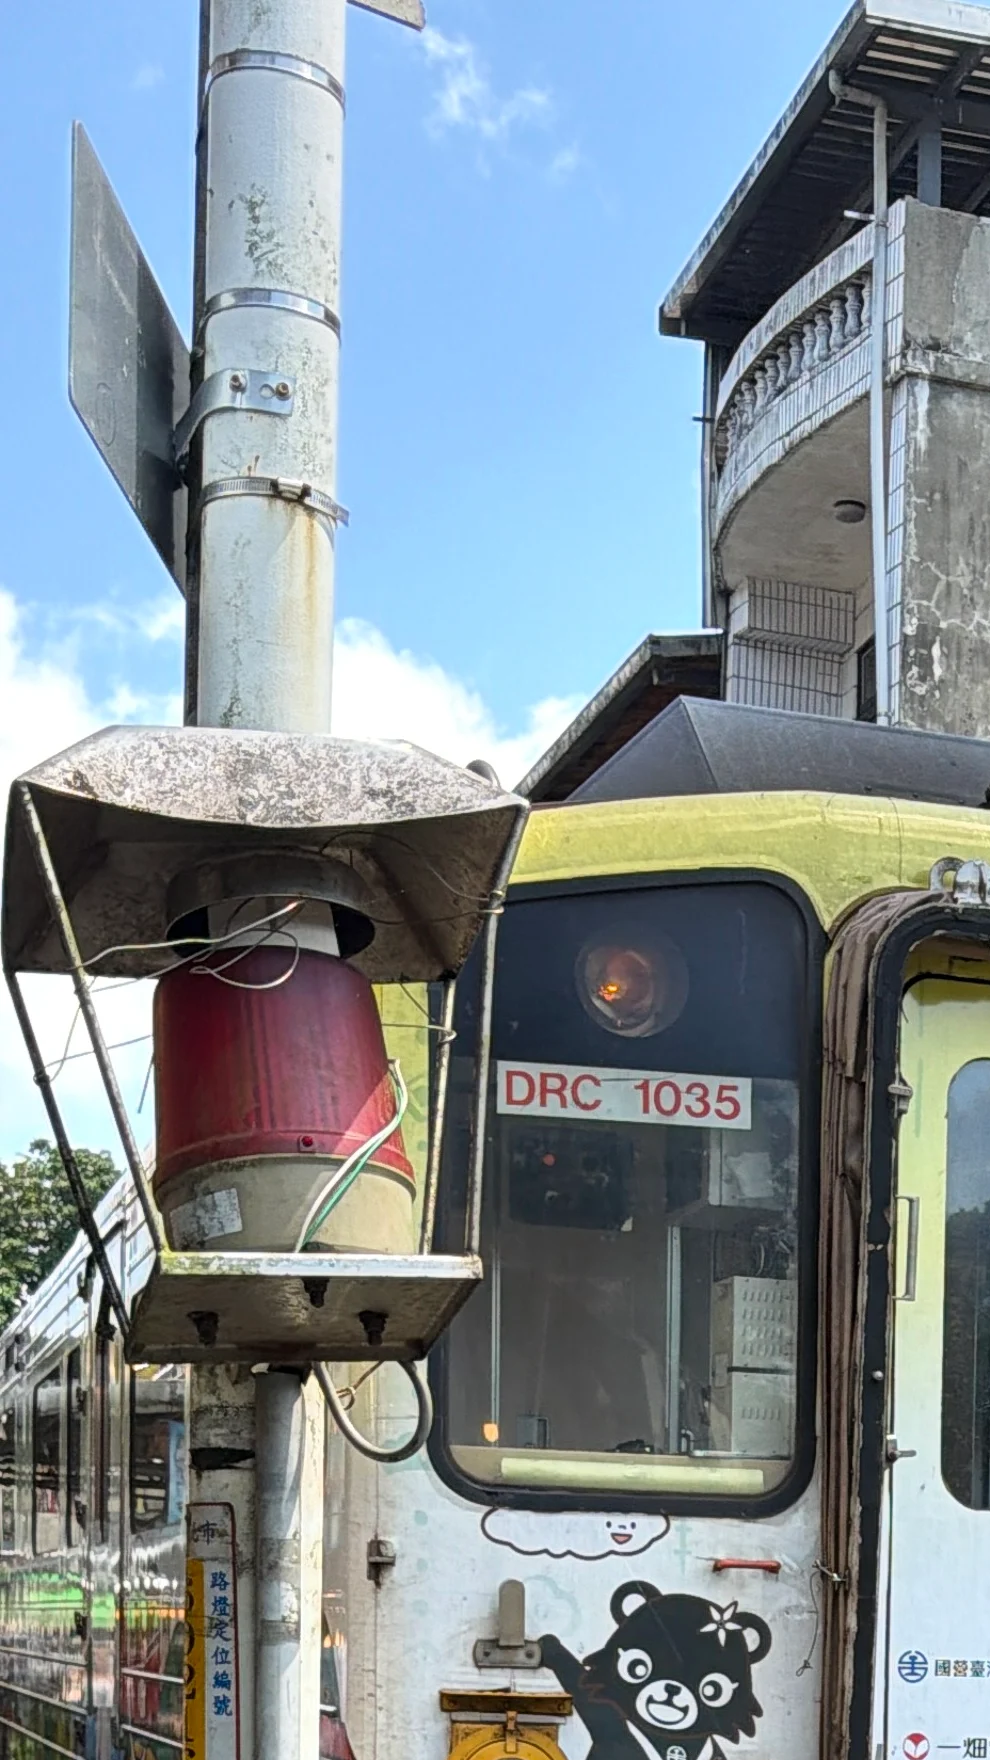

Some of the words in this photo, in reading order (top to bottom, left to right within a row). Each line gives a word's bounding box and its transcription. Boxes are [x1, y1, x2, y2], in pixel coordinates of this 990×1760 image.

[505, 1070, 602, 1111] DRC
[634, 1079, 741, 1121] 1035
[210, 1571, 234, 1717] 路燈定位編號
